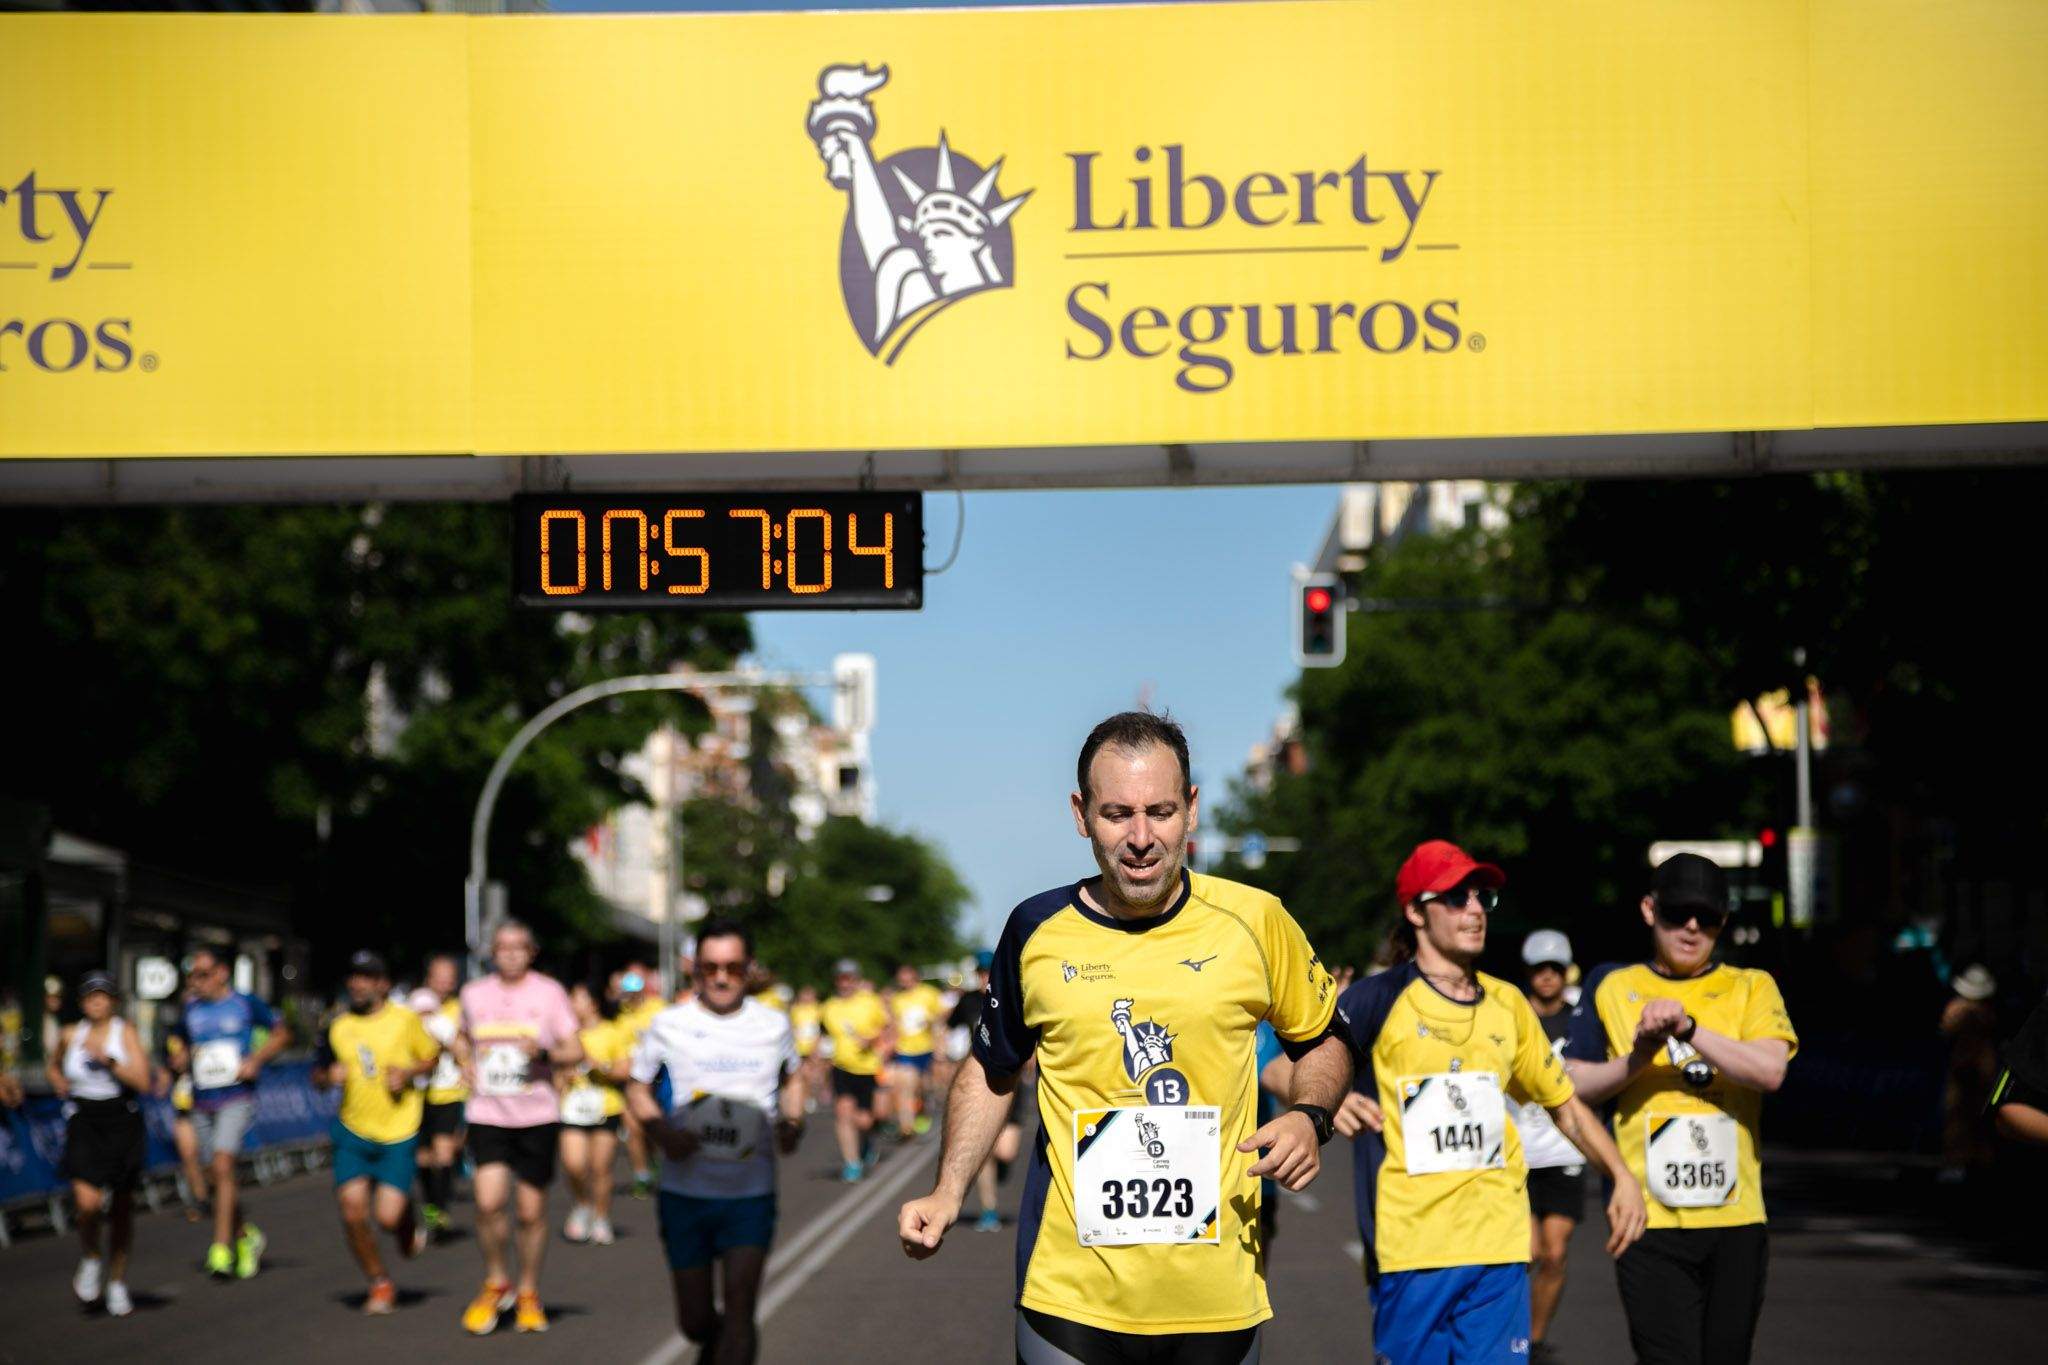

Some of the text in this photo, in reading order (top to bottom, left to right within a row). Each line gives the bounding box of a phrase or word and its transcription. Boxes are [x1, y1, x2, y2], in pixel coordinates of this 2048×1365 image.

[1064, 145, 1441, 262] Liberty
[0, 170, 114, 281] ty
[1065, 283, 1460, 393] Seguros
[1081, 964, 1111, 972] Liberty
[1153, 1079, 1181, 1104] 13
[1150, 1144, 1162, 1155] 13
[1430, 1123, 1483, 1153] 1441
[1665, 1162, 1726, 1190] 3365
[1102, 1178, 1194, 1220] 3323
